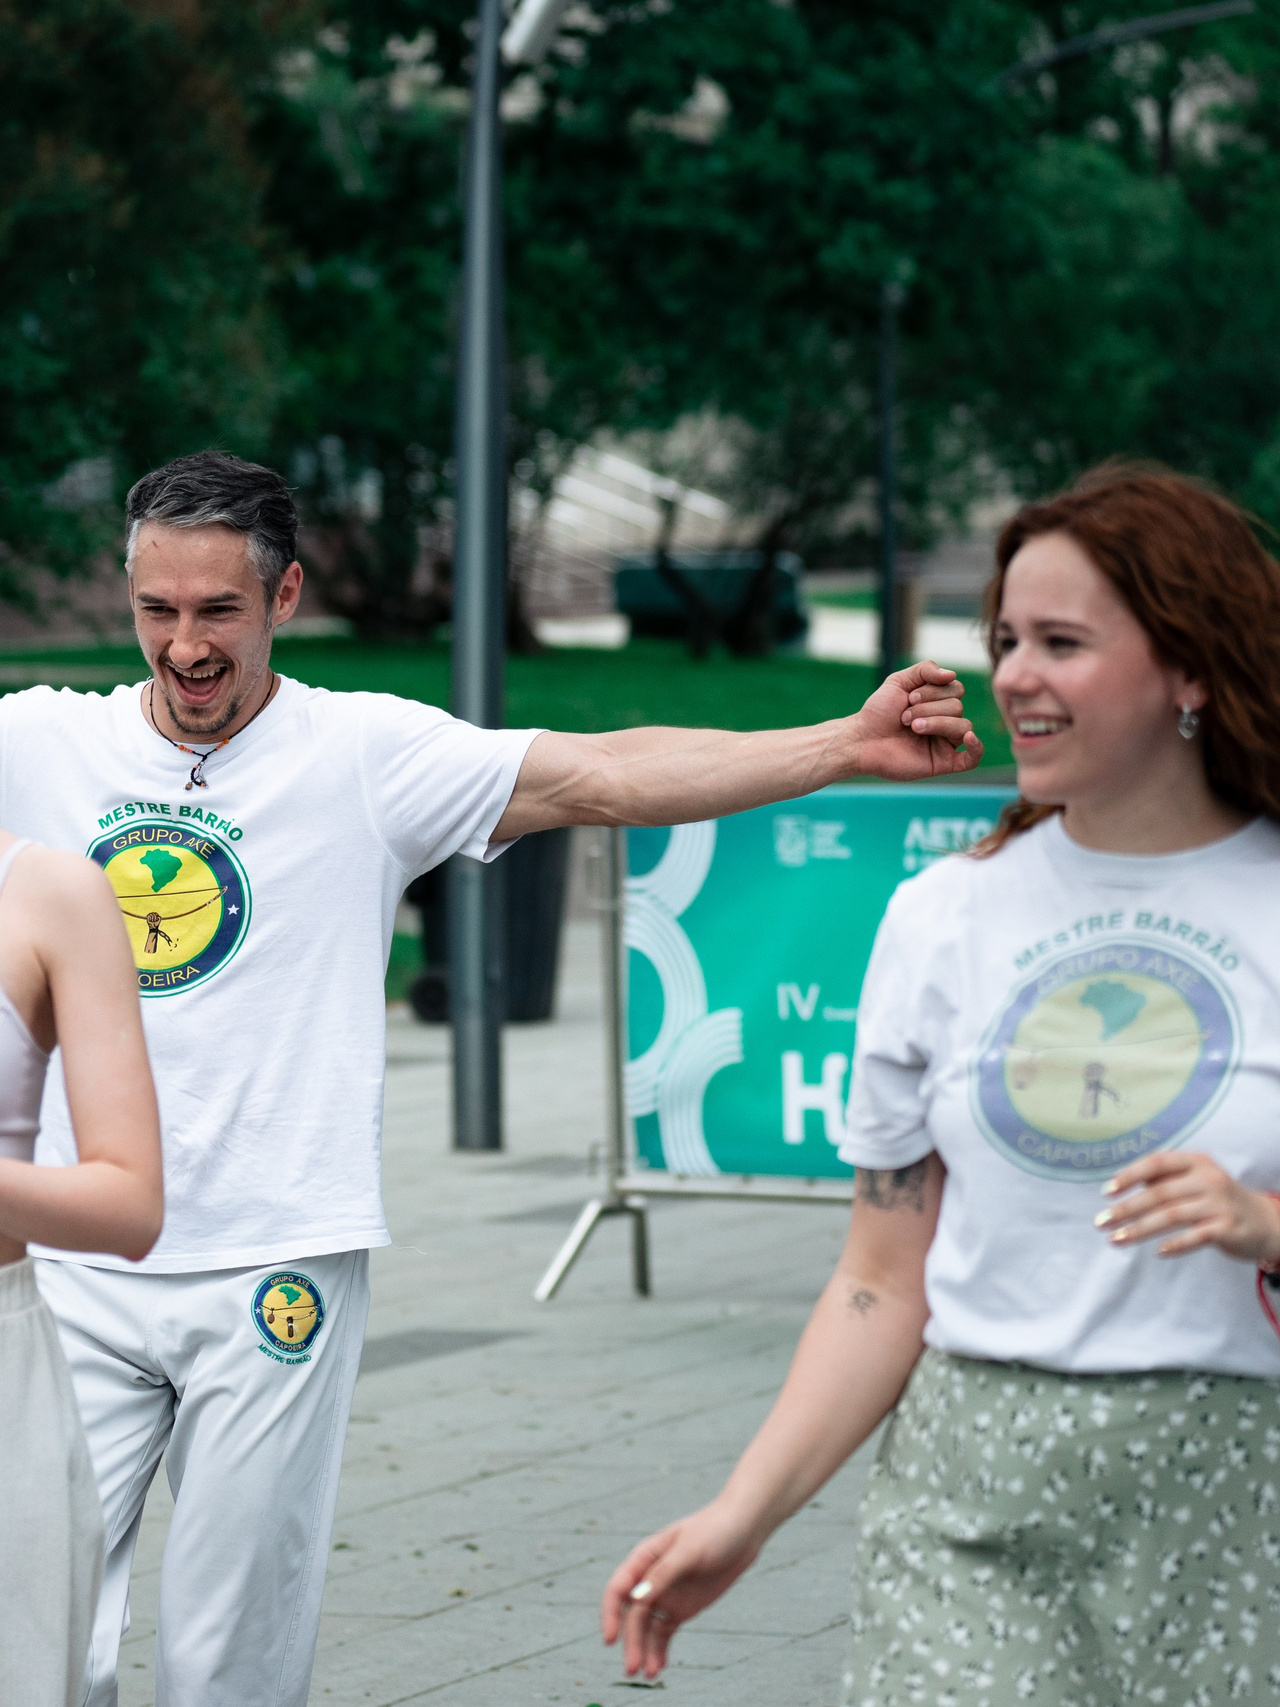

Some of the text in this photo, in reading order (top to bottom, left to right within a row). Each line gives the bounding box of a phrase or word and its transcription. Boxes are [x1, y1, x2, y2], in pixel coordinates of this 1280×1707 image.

[98, 802, 171, 829] MESTRE
[113, 828, 183, 850] GRUPO
[1014, 912, 1240, 971] MESTRE BARRÃO
[137, 965, 200, 987] OEIRA
[1037, 951, 1140, 993] GRUPO
[776, 982, 821, 1021] IV
[1016, 1129, 1160, 1168] CAPOEIRA
[270, 1275, 294, 1286] GRUPO
[257, 1343, 285, 1364] MESTRE
[274, 1340, 306, 1351] CAPOEIRA
